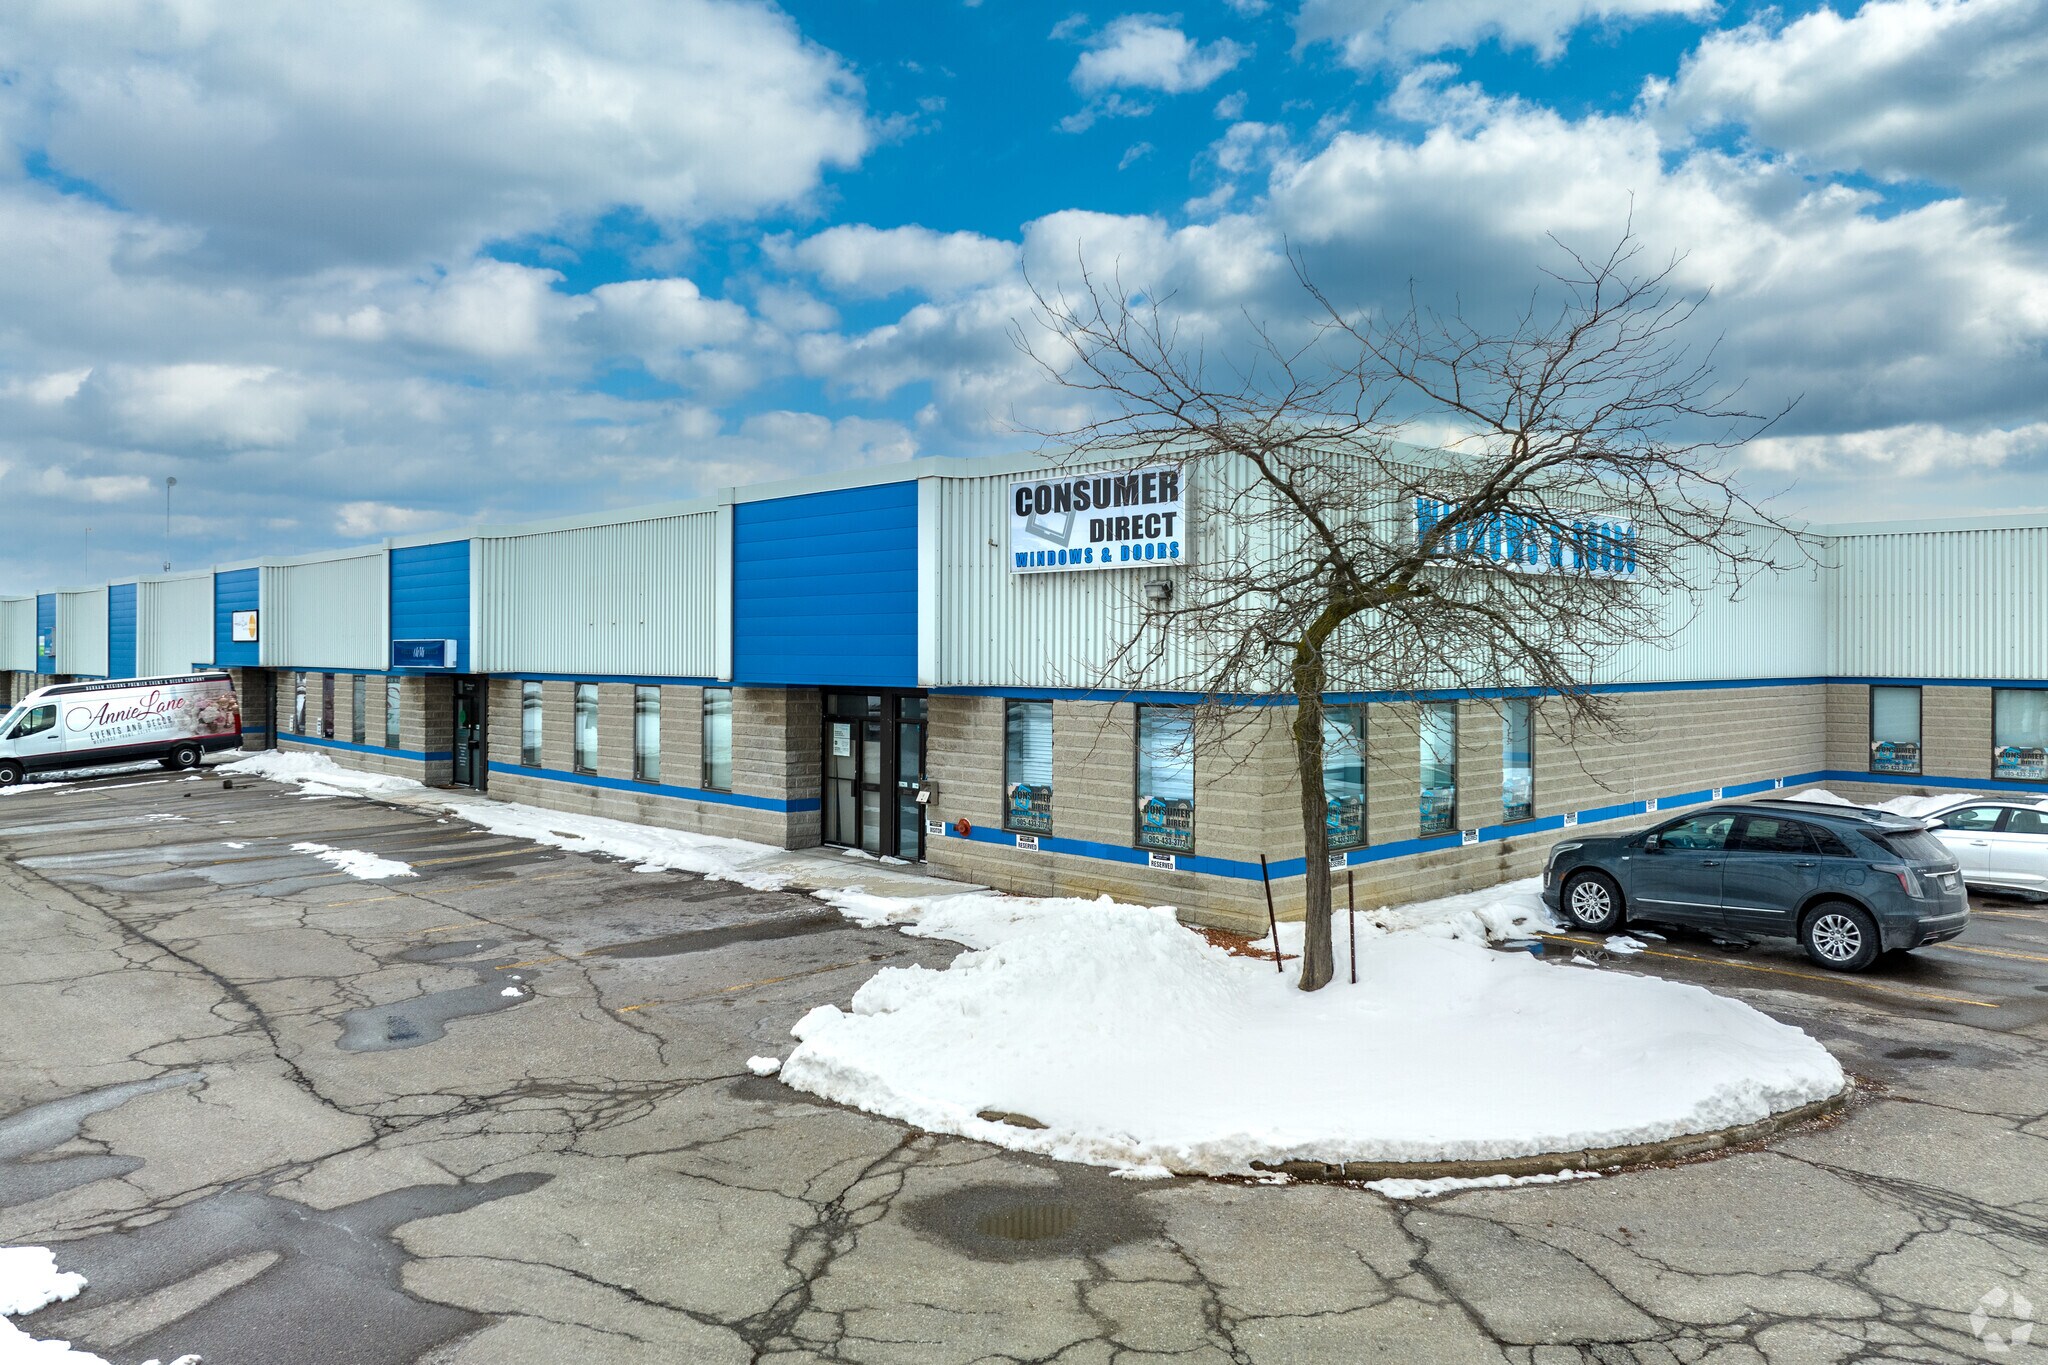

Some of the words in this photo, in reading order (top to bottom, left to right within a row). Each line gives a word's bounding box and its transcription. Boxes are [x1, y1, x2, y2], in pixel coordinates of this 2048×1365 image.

[1015, 471, 1179, 517] CONSUMER
[1089, 511, 1177, 543] DIRECT
[1015, 547, 1093, 568] WINDOWS
[1101, 547, 1112, 563] &
[1120, 541, 1180, 562] DOORS
[65, 702, 139, 732] Annie
[135, 690, 185, 720] Lane
[90, 726, 122, 741] EVENTS
[126, 722, 143, 732] AND
[146, 715, 173, 728] DECOR
[1999, 751, 2045, 760] CONSUMER
[1011, 790, 1051, 804] CONSUMER
[1031, 803, 1051, 812] DIRECT
[1143, 804, 1191, 819] CONSUMER
[1166, 818, 1190, 828] DIRECT
[1018, 841, 1038, 851] RESERVED
[1150, 860, 1174, 870] RESERVED
